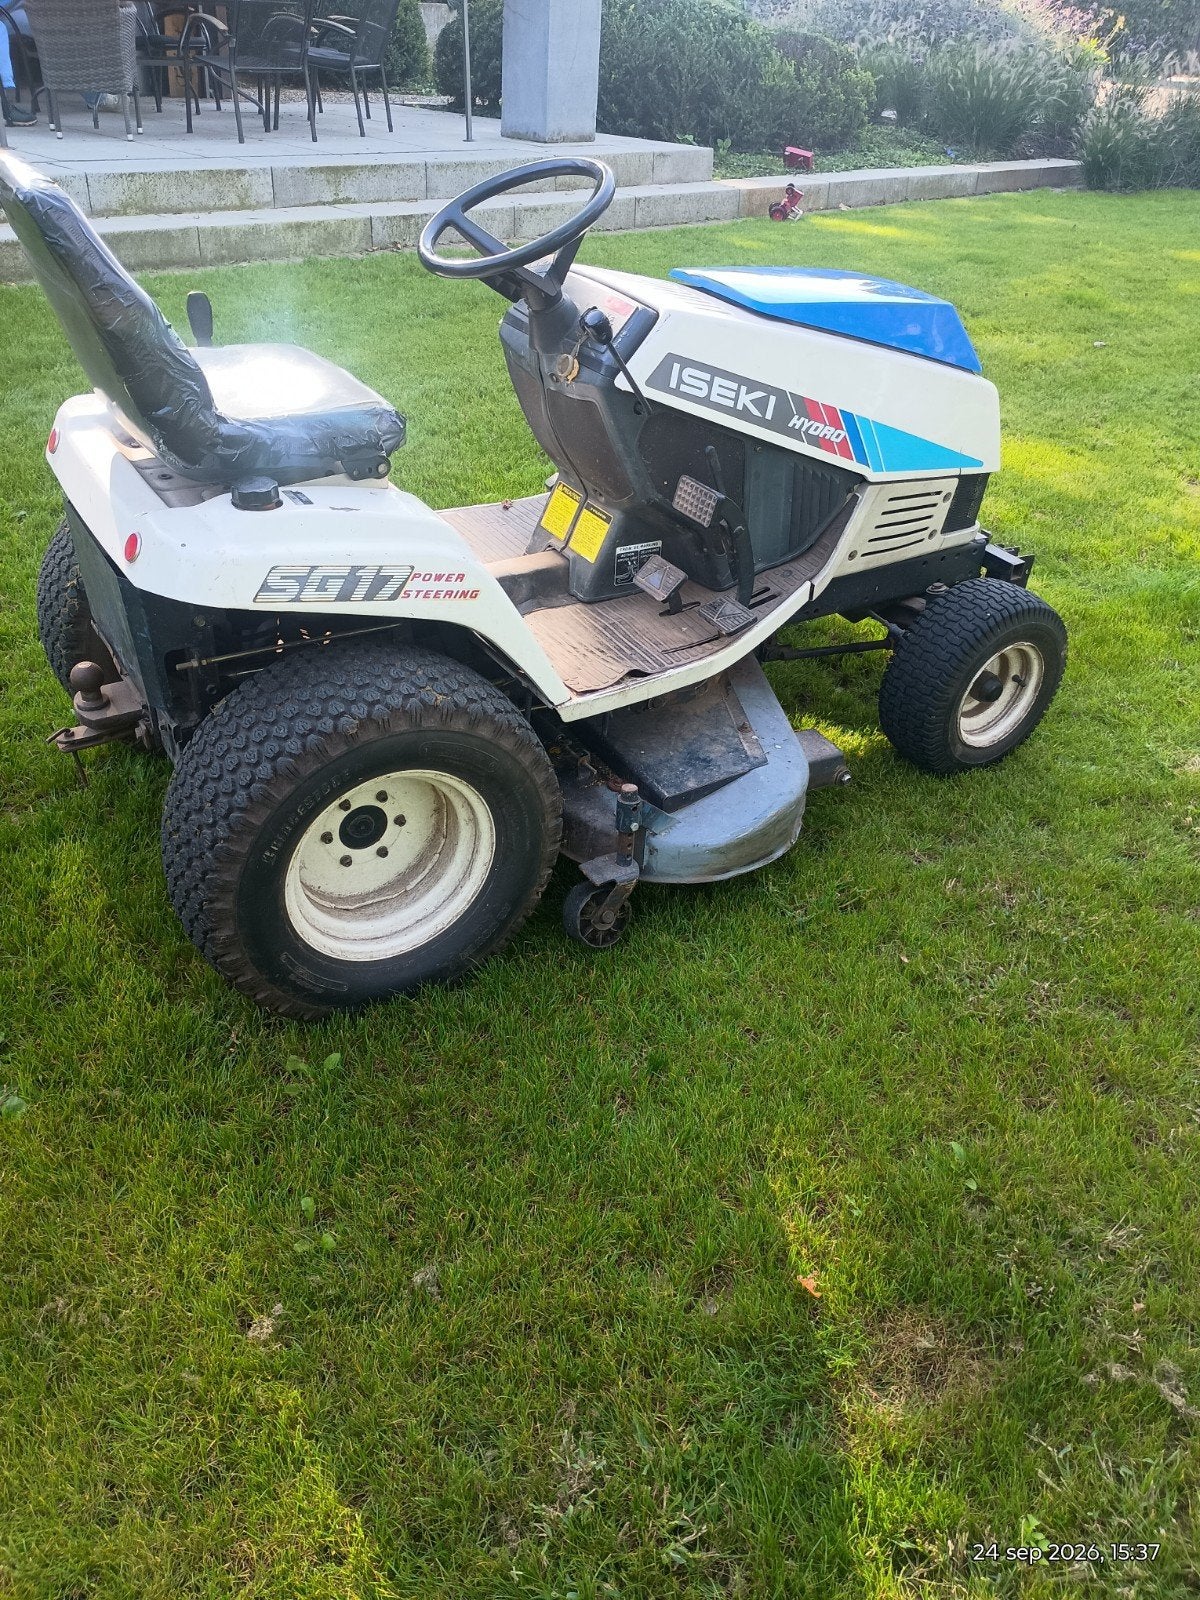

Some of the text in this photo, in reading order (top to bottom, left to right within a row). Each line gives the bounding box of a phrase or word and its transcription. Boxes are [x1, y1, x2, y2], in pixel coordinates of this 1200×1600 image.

[668, 362, 776, 421] ISEKI
[788, 415, 847, 443] HYDRO
[253, 565, 415, 602] SG17
[409, 572, 466, 583] POWER
[401, 589, 480, 600] STEERING
